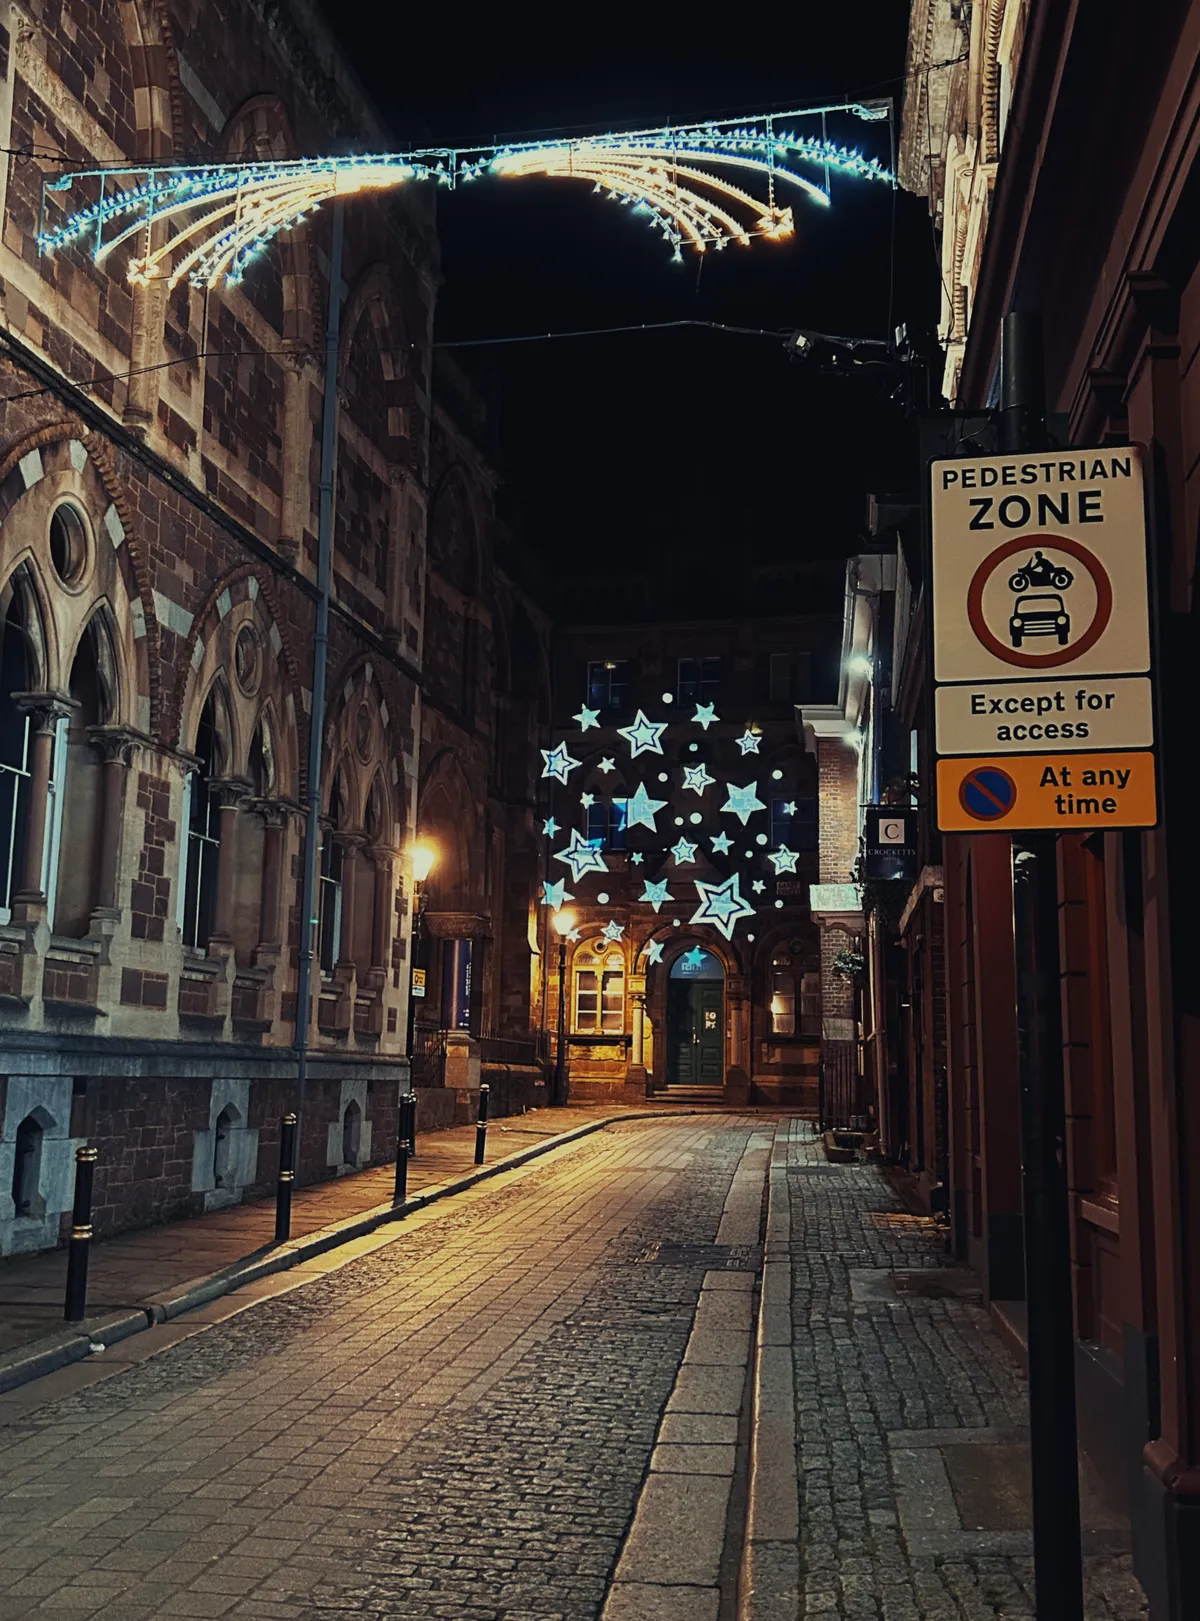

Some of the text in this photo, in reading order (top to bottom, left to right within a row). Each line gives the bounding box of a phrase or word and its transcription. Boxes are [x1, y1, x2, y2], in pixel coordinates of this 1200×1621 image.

[943, 457, 1131, 490] PEDESTRIAN
[969, 490, 1104, 531] ZONE
[972, 690, 1115, 716] Except for
[997, 723, 1088, 740] access
[1040, 767, 1130, 789] At any
[1055, 794, 1116, 814] time
[885, 824, 898, 839] C
[868, 848, 916, 856] CROCKETTS
